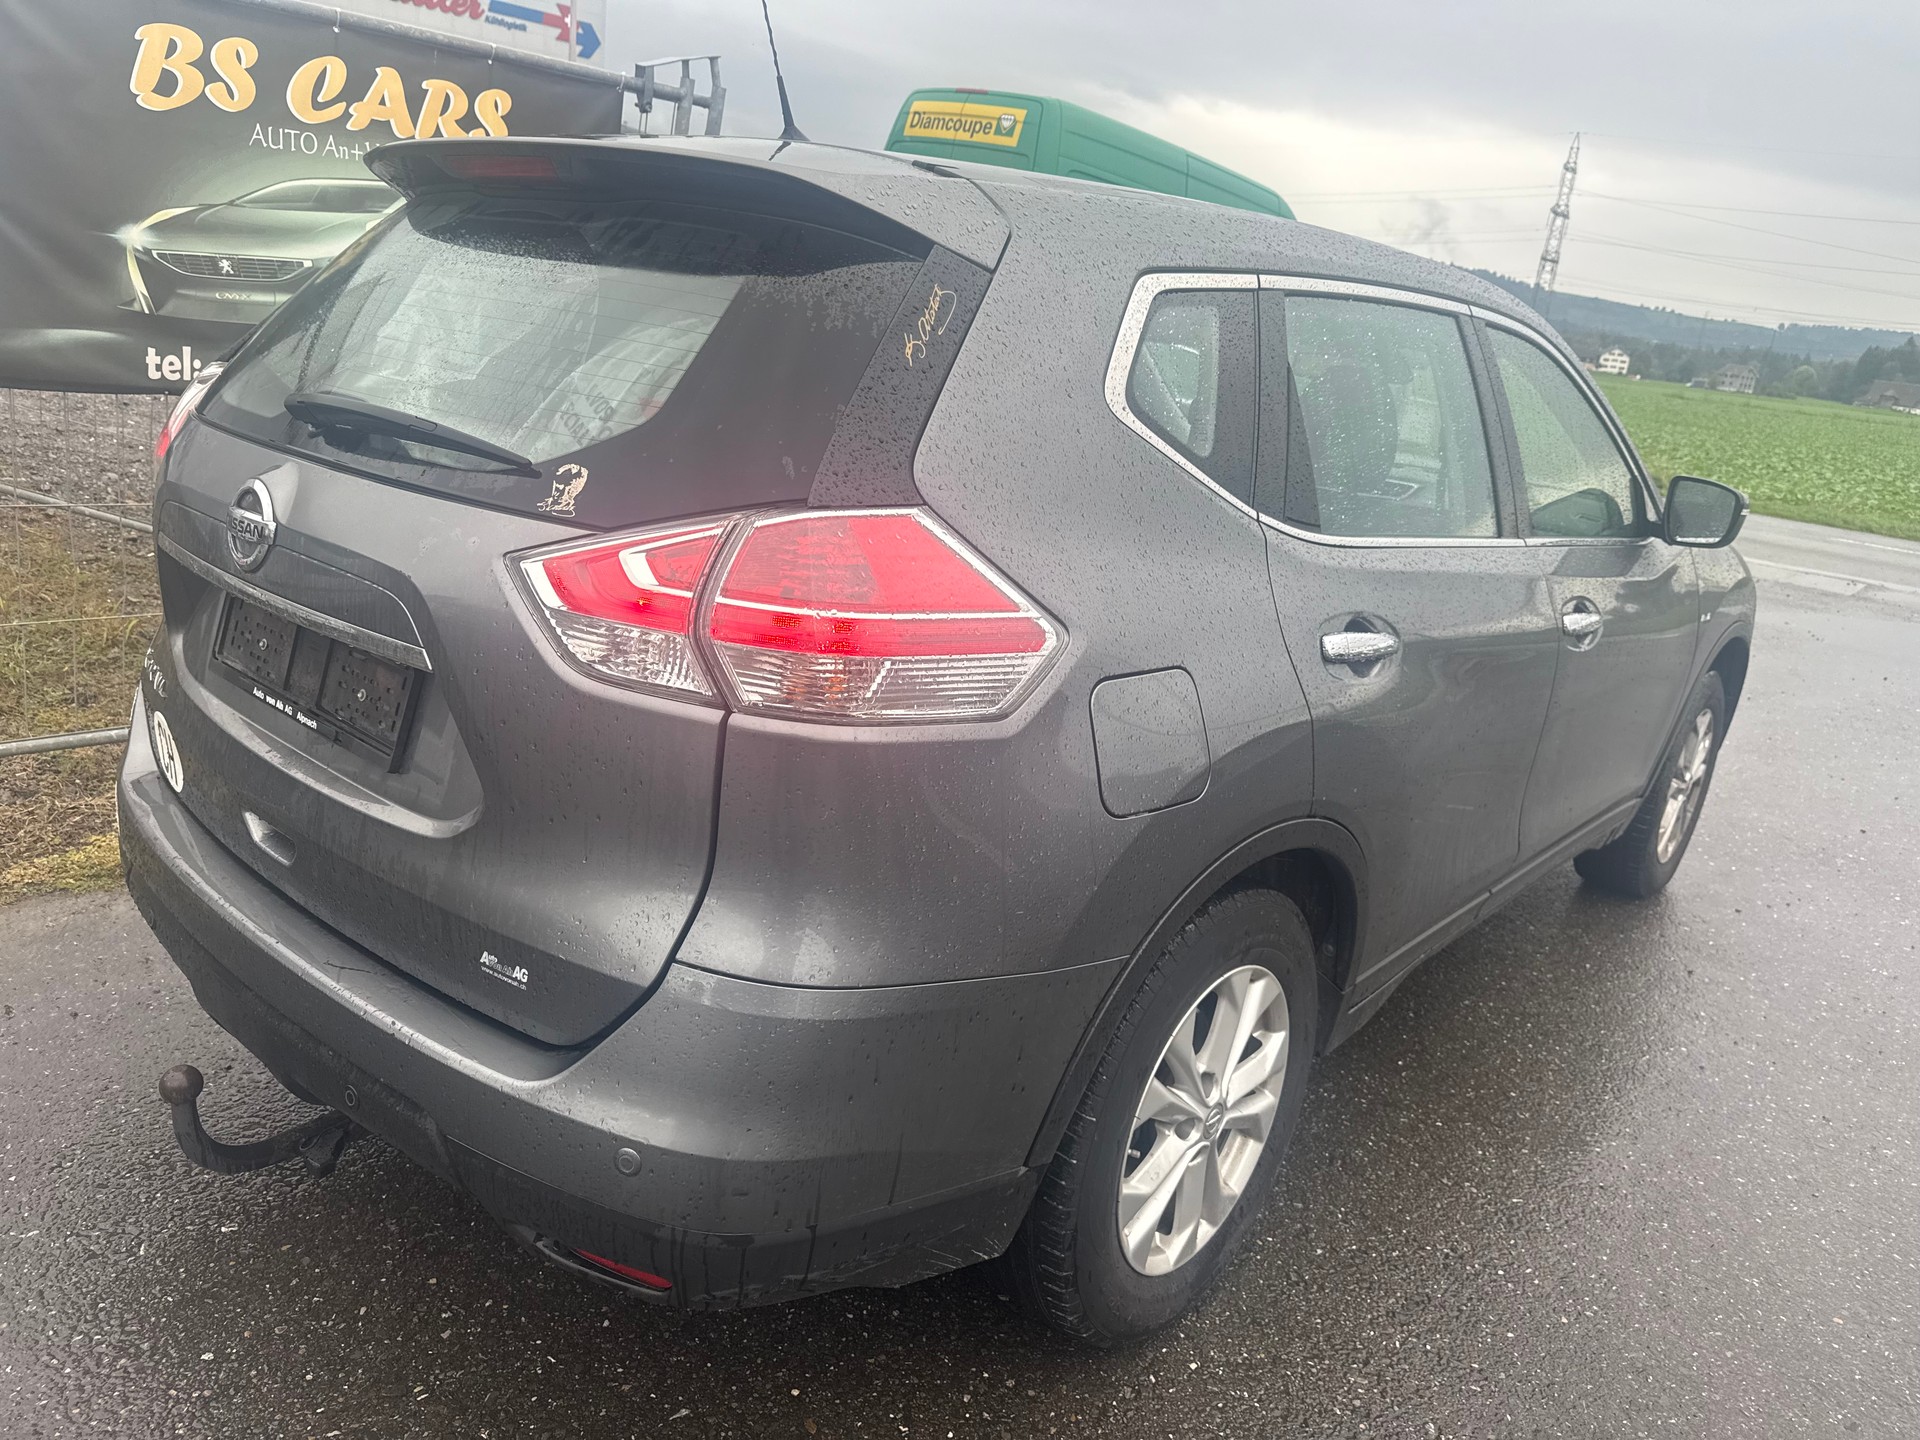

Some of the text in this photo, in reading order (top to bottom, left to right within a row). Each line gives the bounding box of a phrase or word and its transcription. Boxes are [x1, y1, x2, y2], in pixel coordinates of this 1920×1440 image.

[129, 22, 513, 139] BS CARS
[249, 123, 318, 154] AUTO
[909, 110, 993, 138] Diamcoupe
[252, 686, 265, 700] Auto
[284, 704, 293, 716] AG
[296, 711, 318, 730] Alpnach
[512, 965, 529, 983] AG
